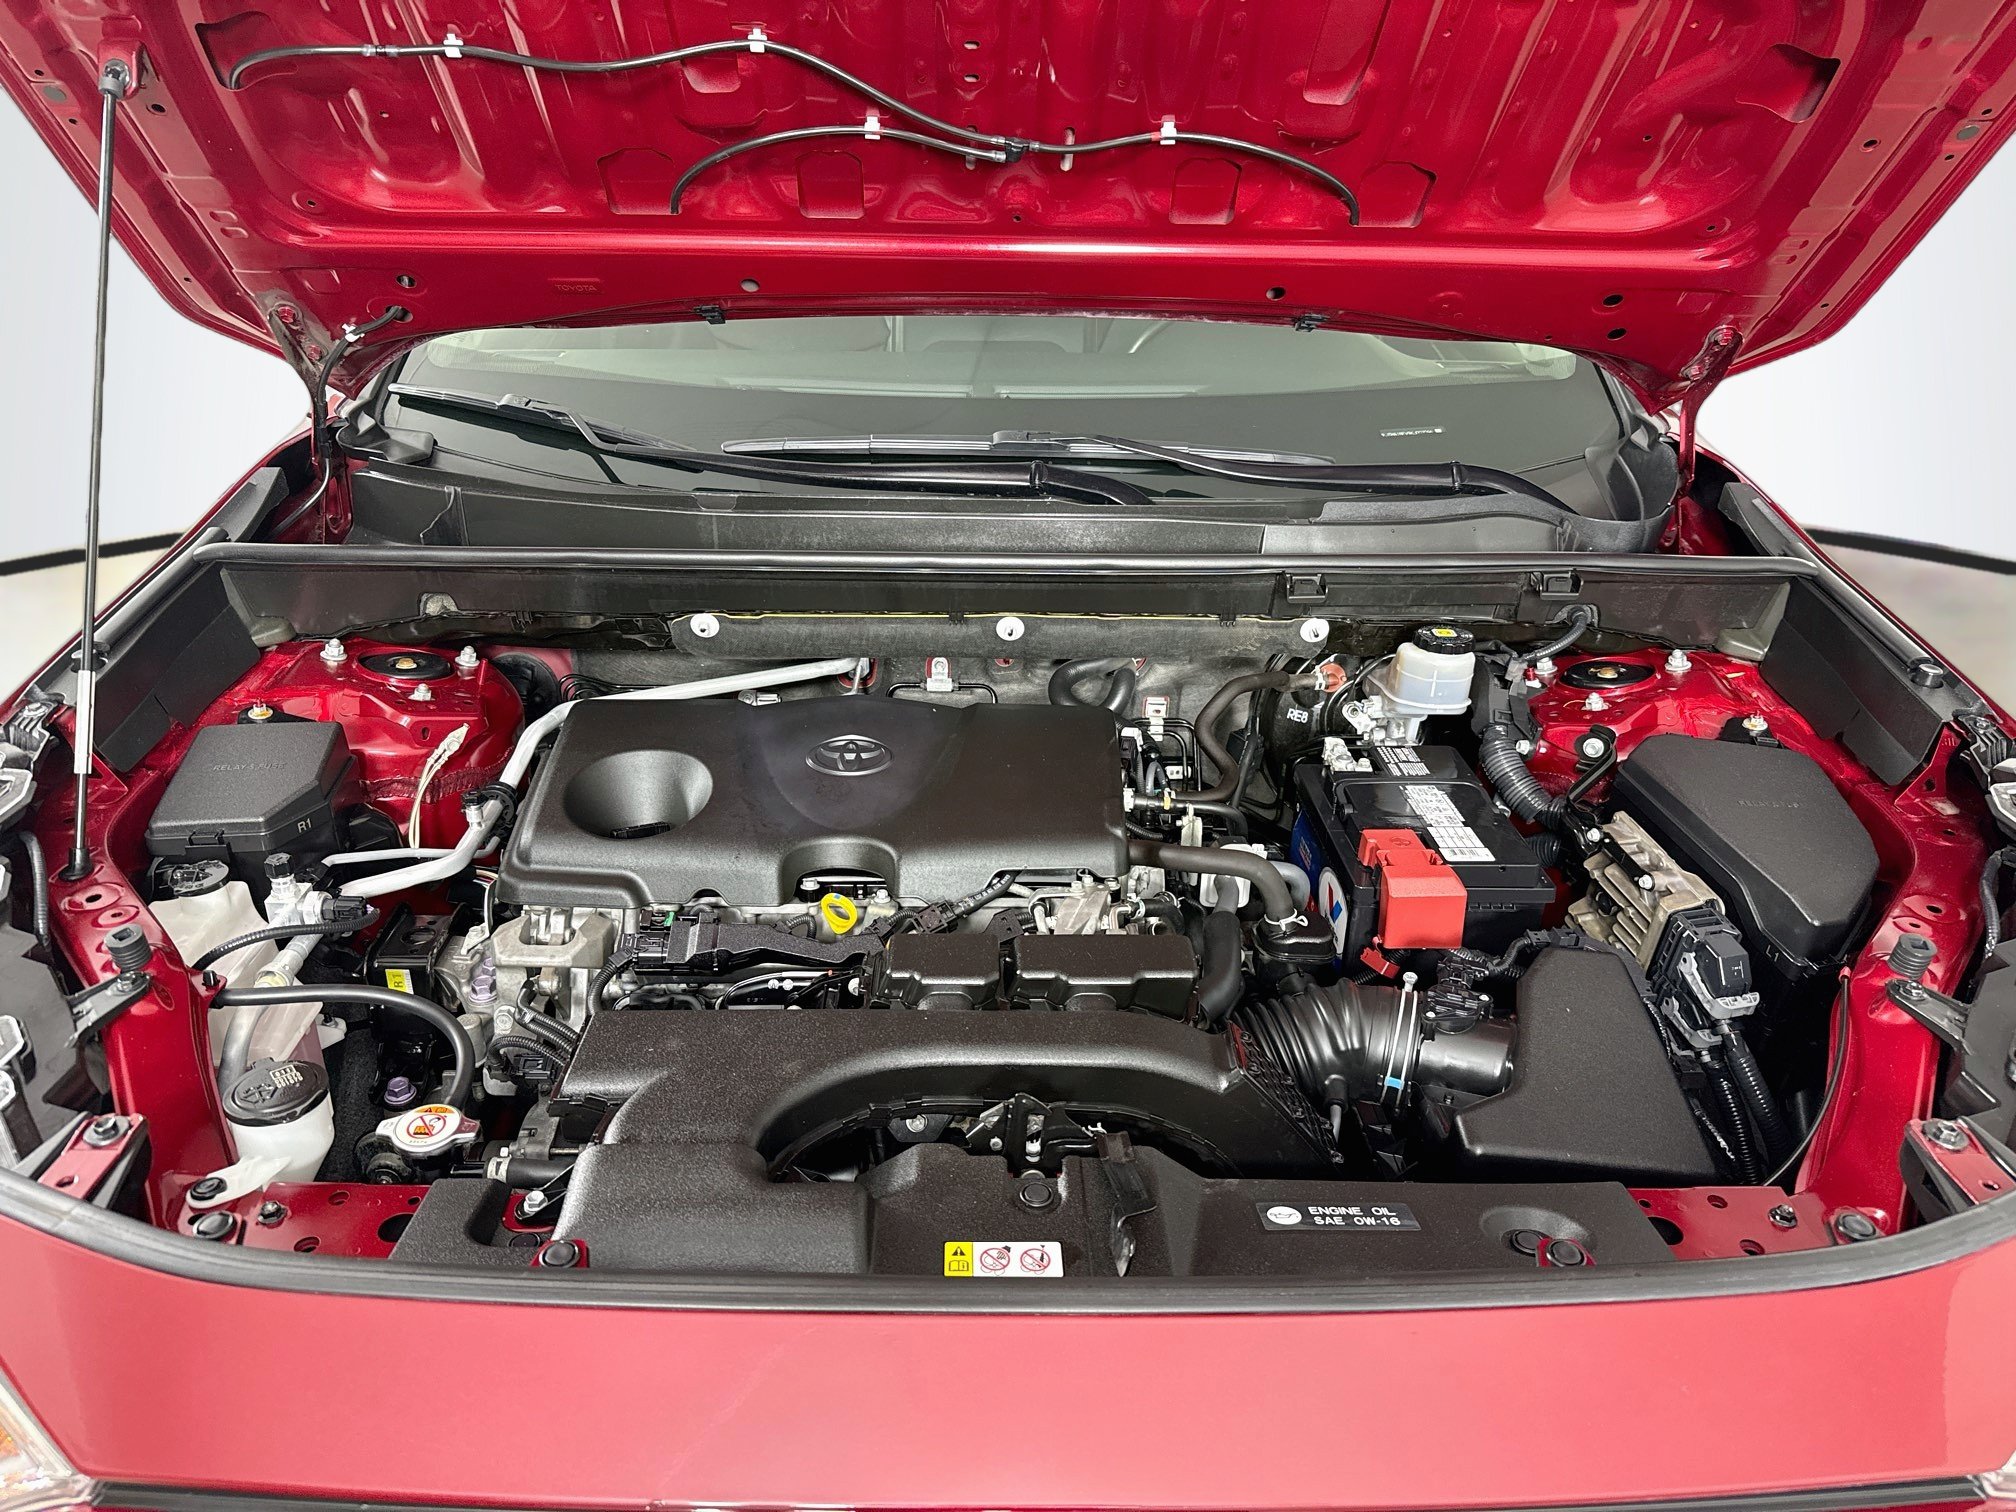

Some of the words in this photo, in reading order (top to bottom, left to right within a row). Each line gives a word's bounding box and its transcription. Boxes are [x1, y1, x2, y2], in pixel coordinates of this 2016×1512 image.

[1286, 708, 1309, 723] RE8
[297, 818, 311, 833] R1
[1765, 944, 1779, 962] L1
[1308, 1206, 1363, 1216] ENGINE
[1372, 1206, 1396, 1216] OIL
[1314, 1216, 1345, 1226] SAE
